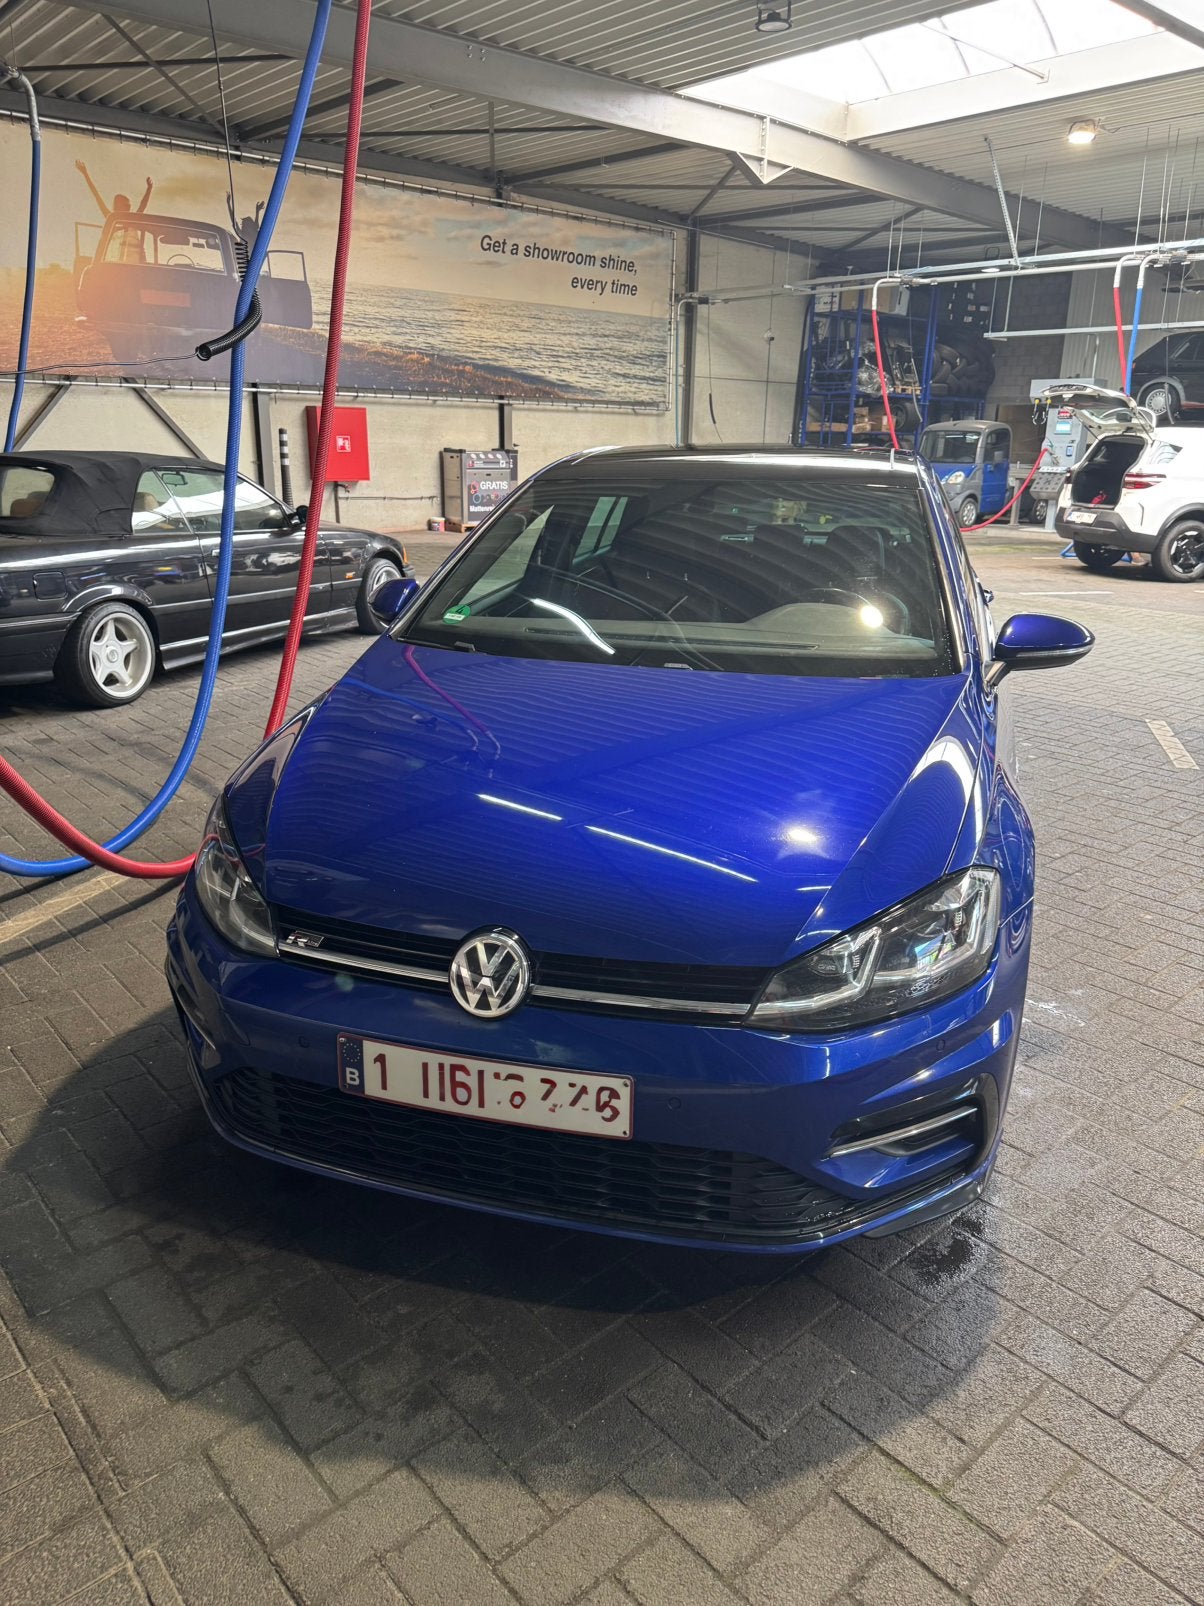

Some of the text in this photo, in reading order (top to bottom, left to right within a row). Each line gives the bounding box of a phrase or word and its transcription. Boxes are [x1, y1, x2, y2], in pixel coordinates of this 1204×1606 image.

[480, 234, 637, 276] Get a showroom shine,
[571, 276, 637, 296] every time
[480, 481, 508, 490] GRATIS
[345, 1067, 360, 1086] B
